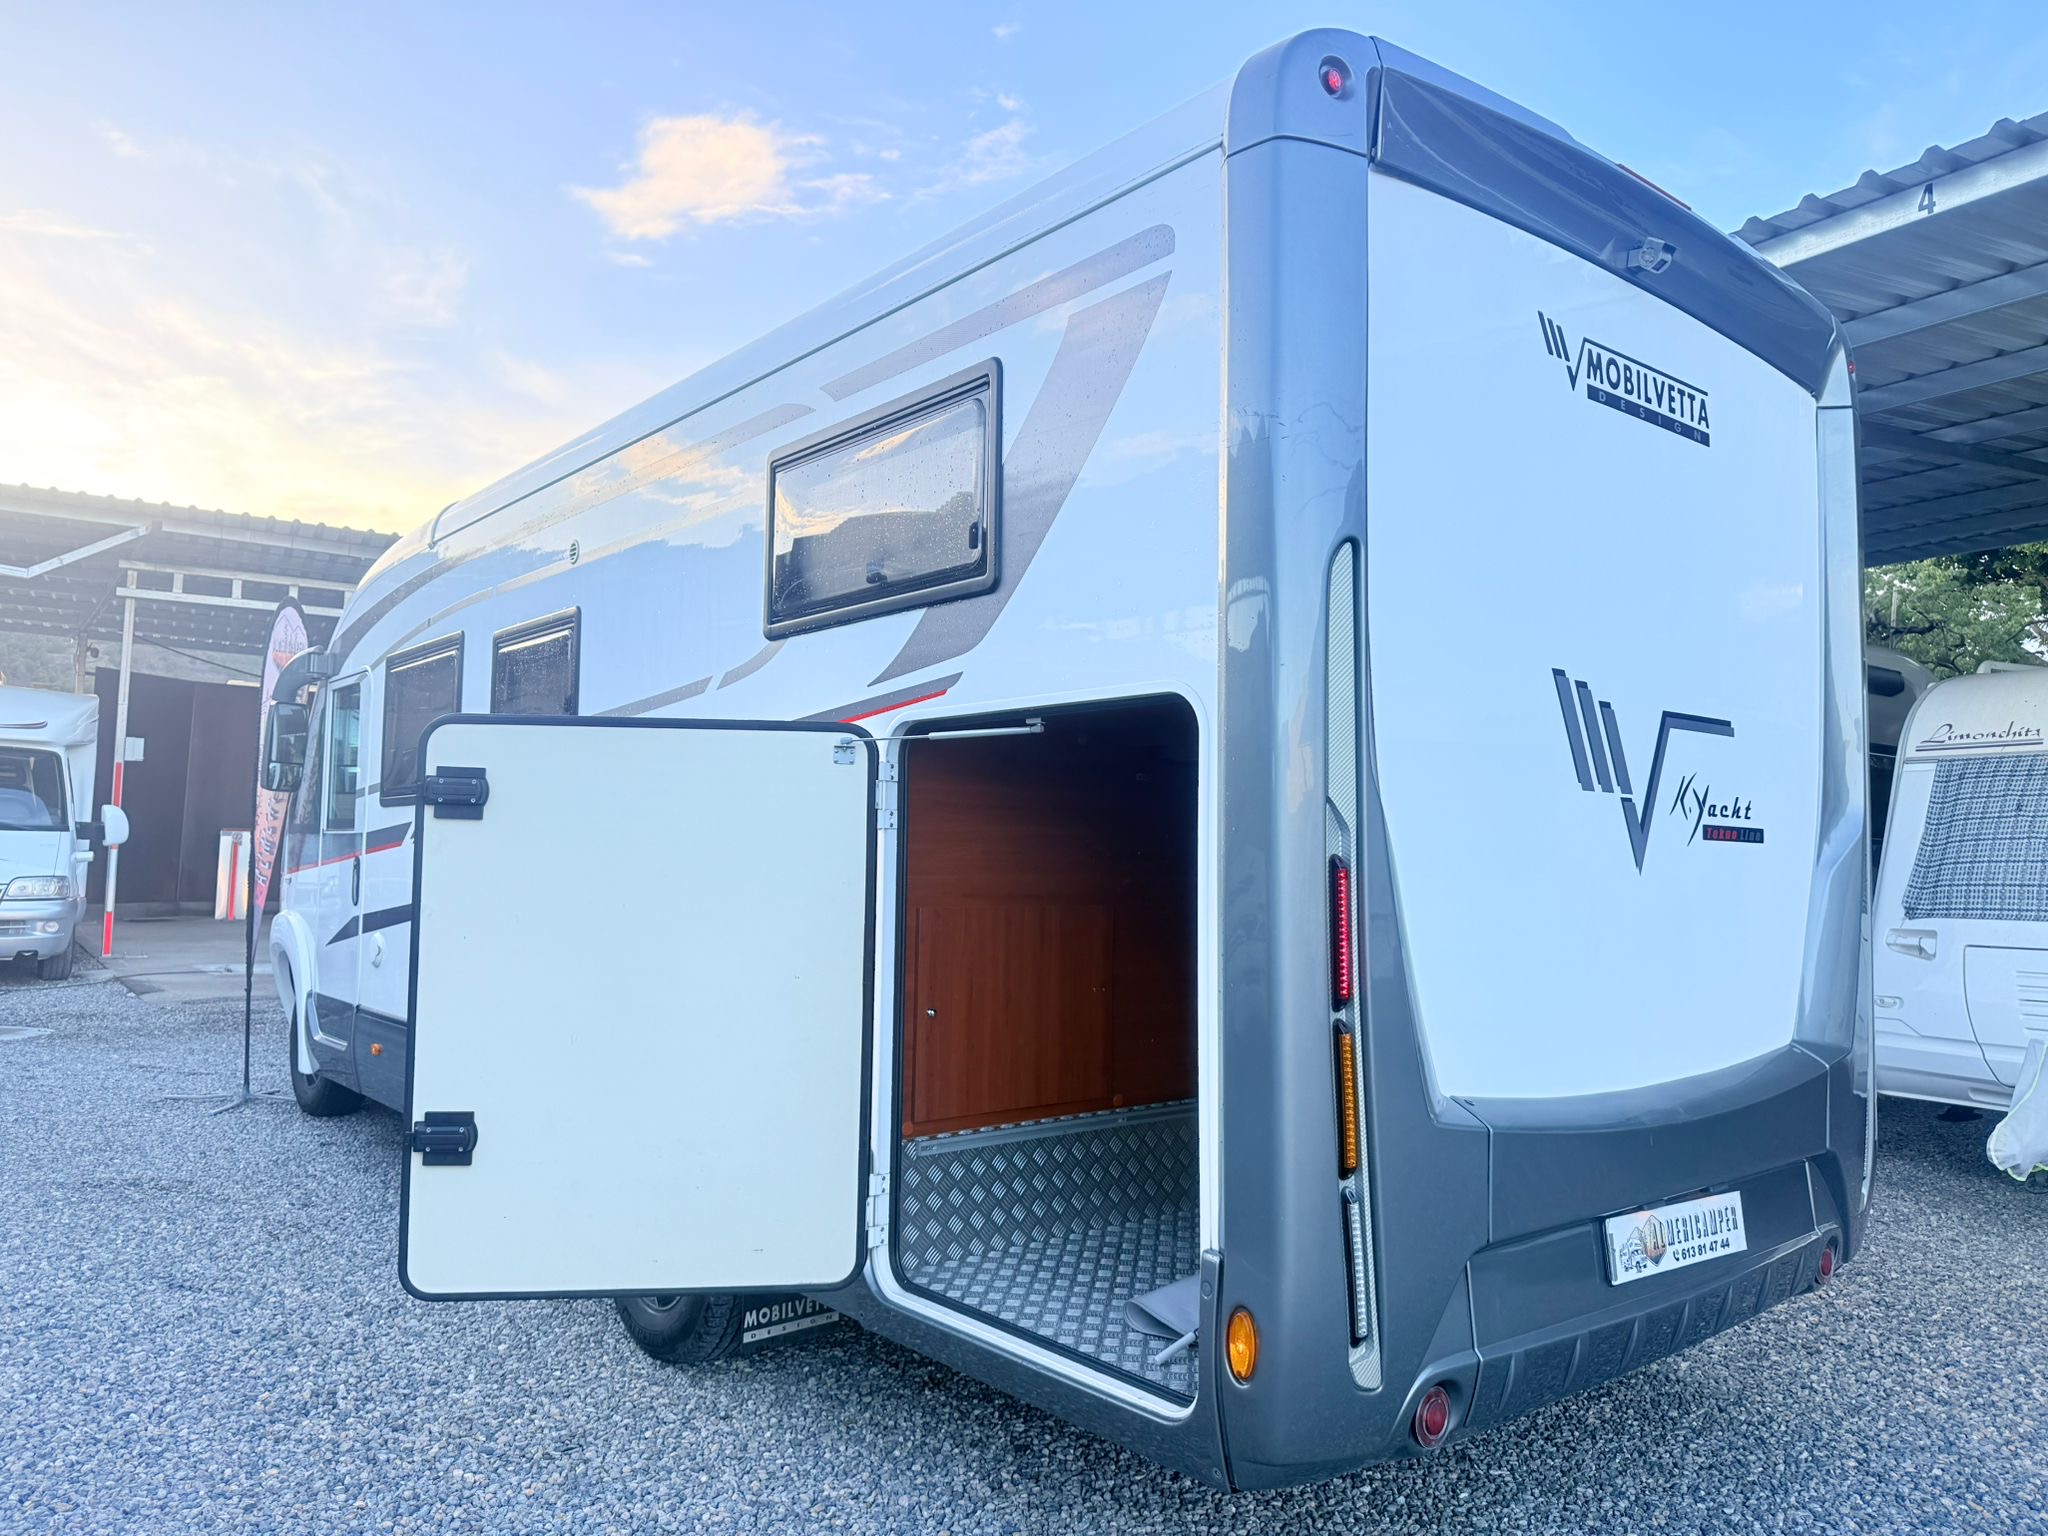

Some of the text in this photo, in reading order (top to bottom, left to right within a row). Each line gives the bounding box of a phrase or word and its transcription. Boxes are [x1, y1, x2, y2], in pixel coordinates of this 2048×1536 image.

[1917, 182, 1937, 215] 4
[1586, 347, 1710, 429] MOBILVETTA
[1599, 391, 1702, 442] DESIGN
[1681, 1237, 1731, 1261] 613 81 47 44
